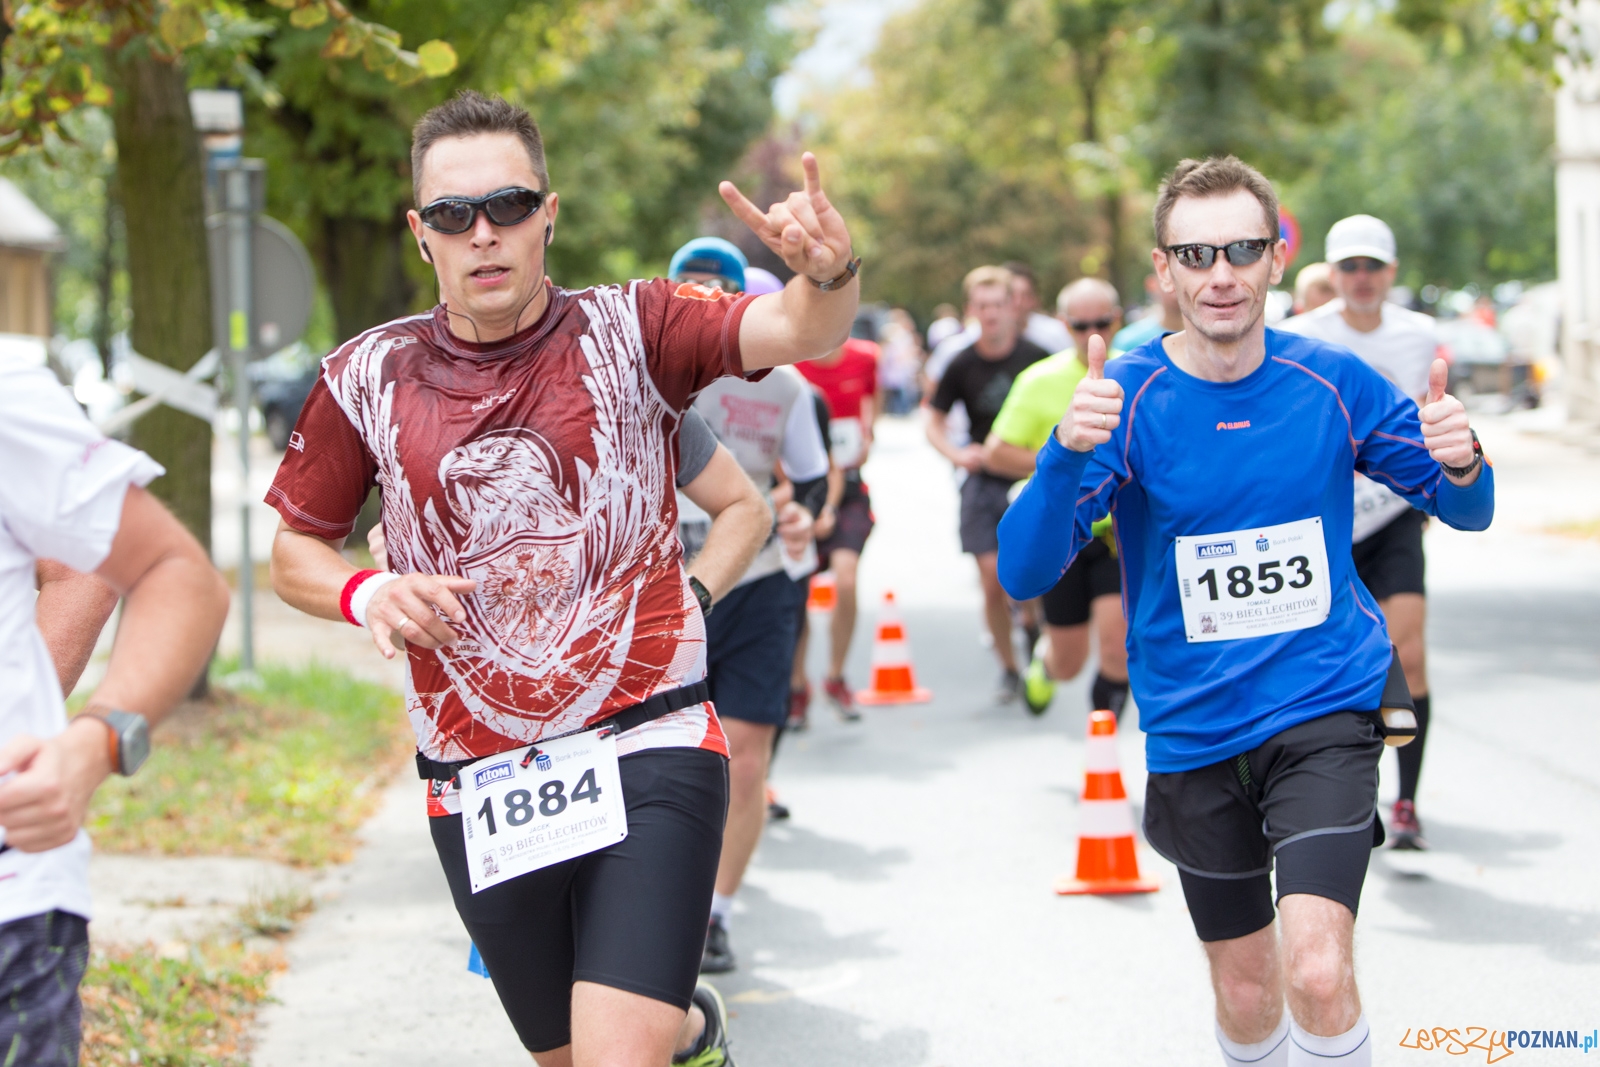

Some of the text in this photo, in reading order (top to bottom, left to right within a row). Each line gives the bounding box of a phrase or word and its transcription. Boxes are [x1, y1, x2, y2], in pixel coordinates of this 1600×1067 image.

[1197, 555, 1313, 601] 1853
[1220, 612, 1233, 621] 39
[1236, 608, 1263, 619] BIEG
[1265, 596, 1318, 615] LECHITÓW
[1246, 599, 1271, 607] TOMASZ
[456, 644, 481, 653] SURGE
[477, 767, 603, 836] 1884
[499, 844, 513, 857] 39
[516, 833, 545, 851] BIEG
[547, 812, 609, 841] LECHITÓW
[529, 823, 551, 834] JACEK
